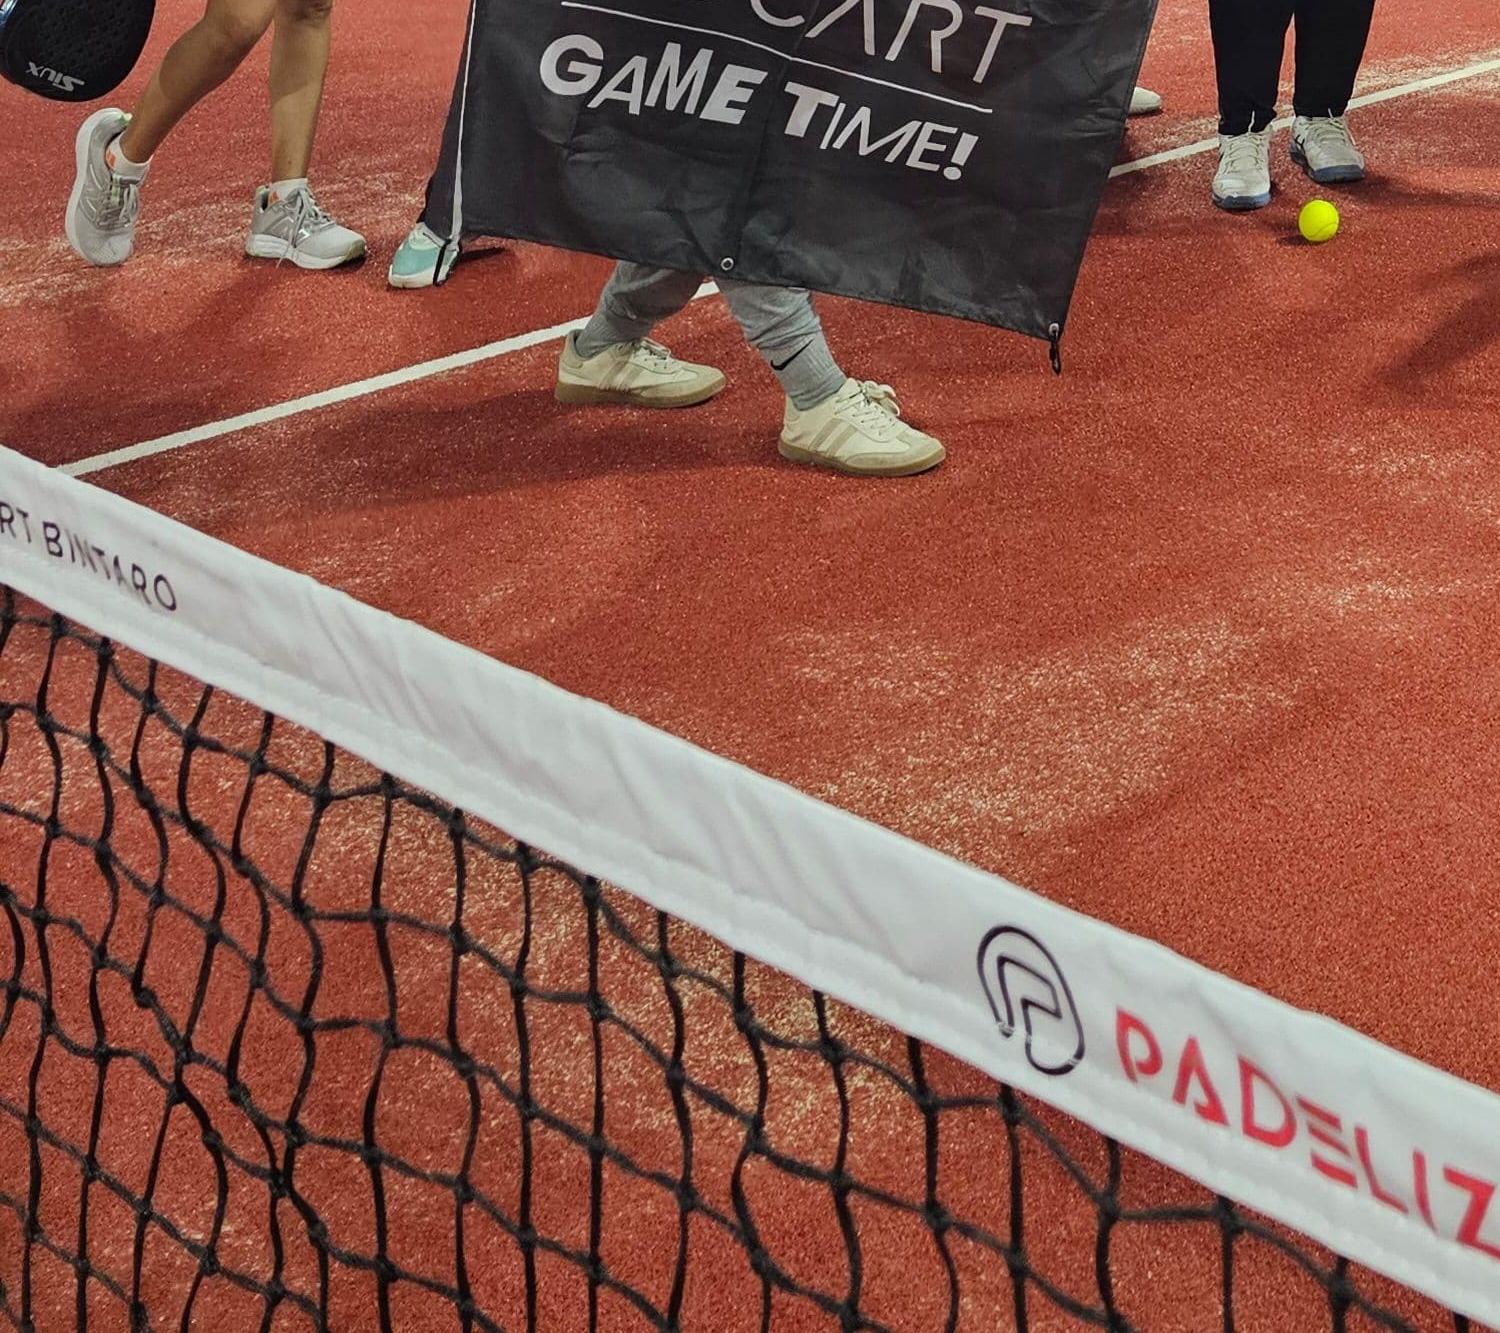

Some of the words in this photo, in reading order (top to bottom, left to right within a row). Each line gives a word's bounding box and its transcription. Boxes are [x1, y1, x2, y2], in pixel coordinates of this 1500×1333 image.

[25, 61, 85, 92] SIUX
[540, 34, 768, 124] GAME
[783, 81, 978, 181] TIME!
[43, 521, 177, 611] BINTARO
